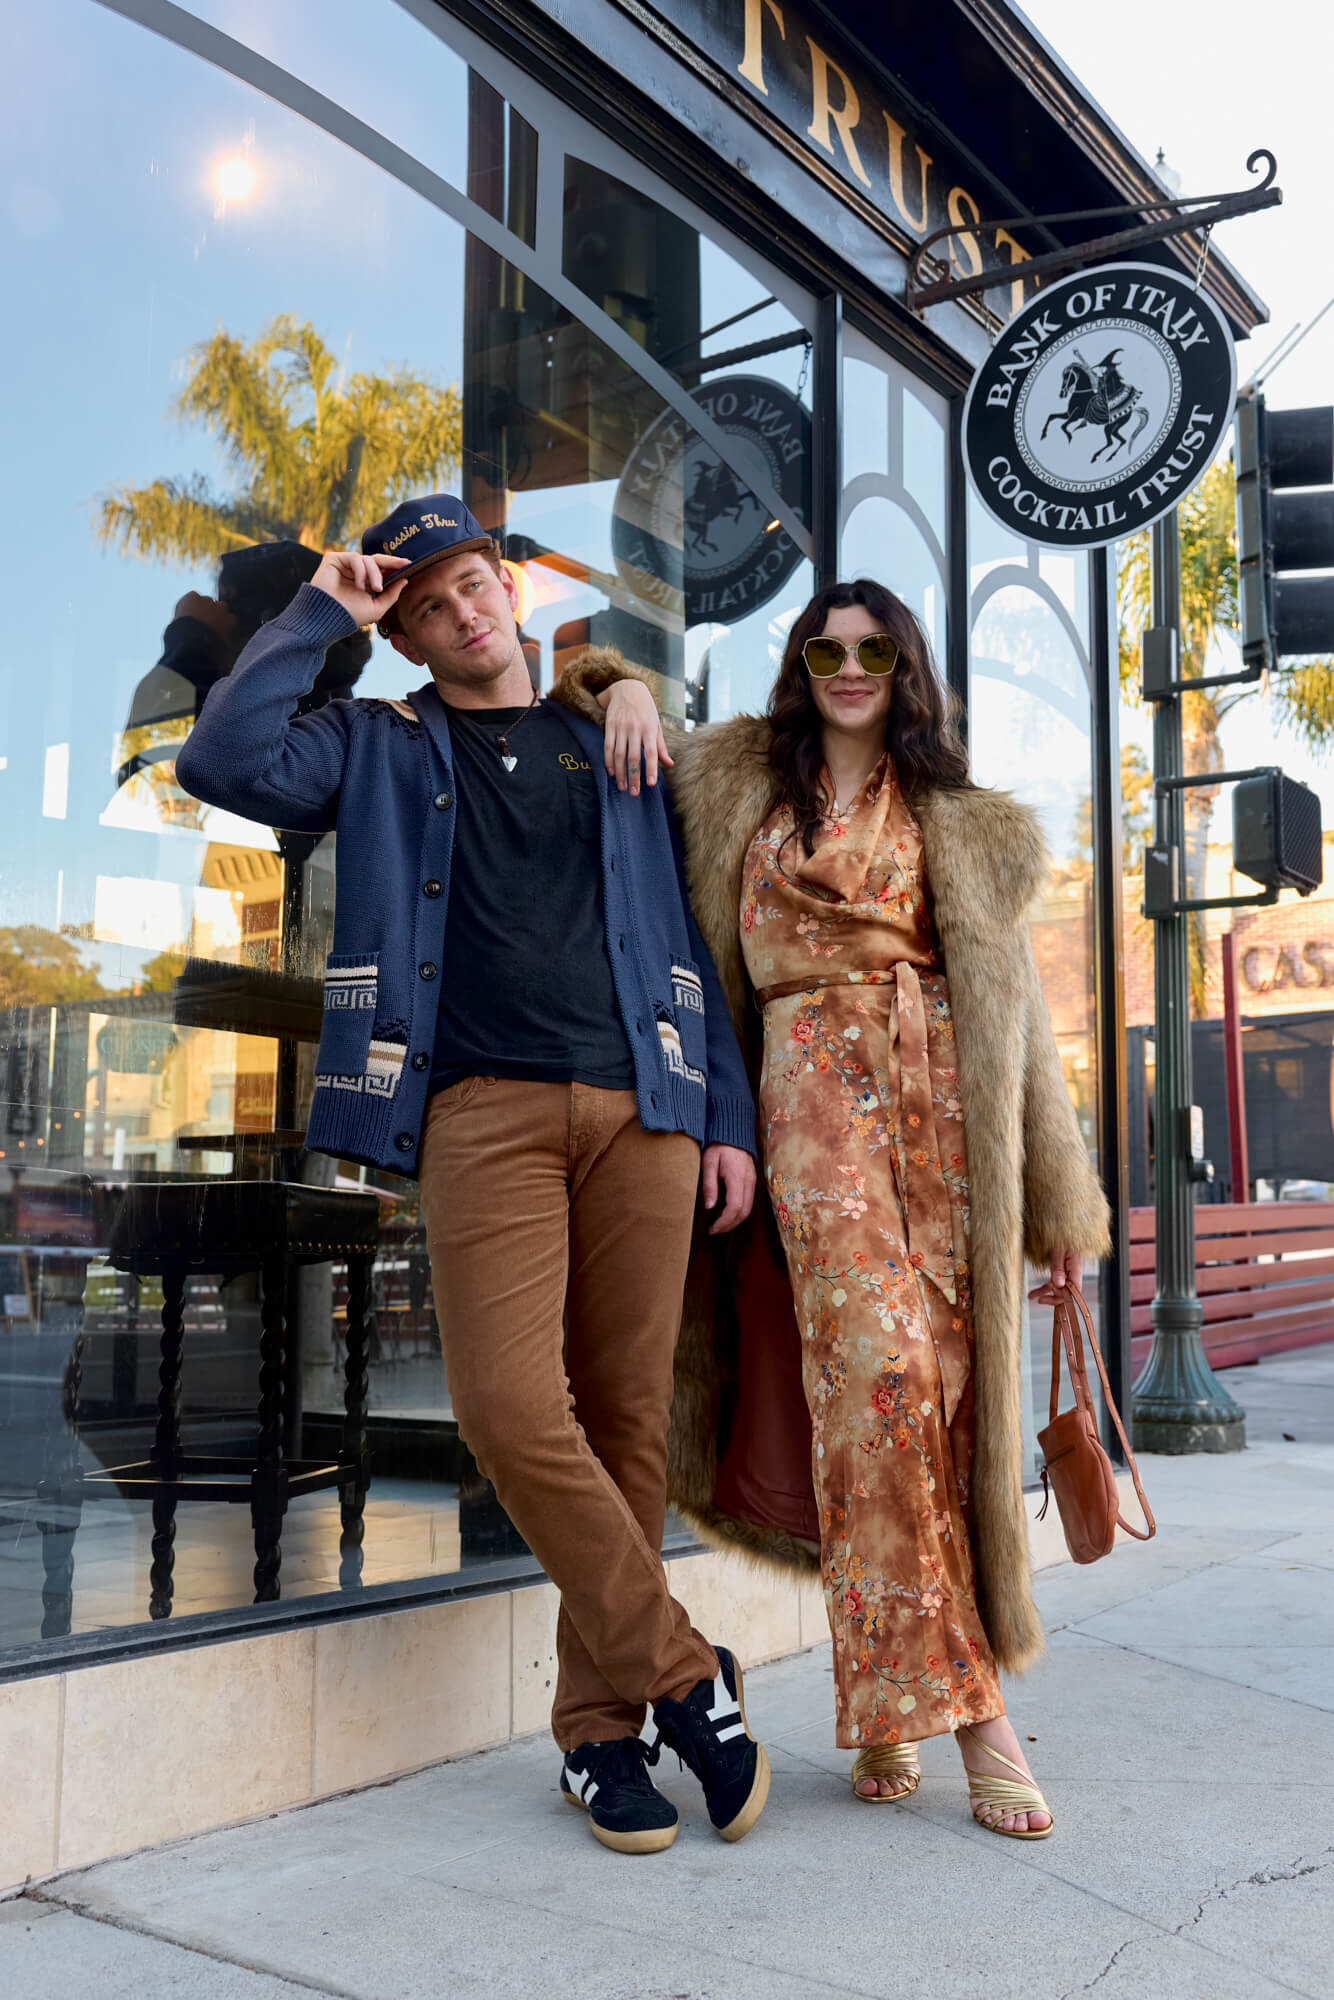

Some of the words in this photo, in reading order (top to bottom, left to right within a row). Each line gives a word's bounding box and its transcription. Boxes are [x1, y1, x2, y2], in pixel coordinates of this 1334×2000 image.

[737, 0, 1039, 318] TRUST
[985, 309, 1062, 409] BANK
[1065, 283, 1117, 319] OF
[1122, 283, 1210, 351] ITALY
[420, 514, 458, 529] Thru
[987, 456, 1127, 531] COCKTAIL
[1128, 404, 1214, 510] TRUST
